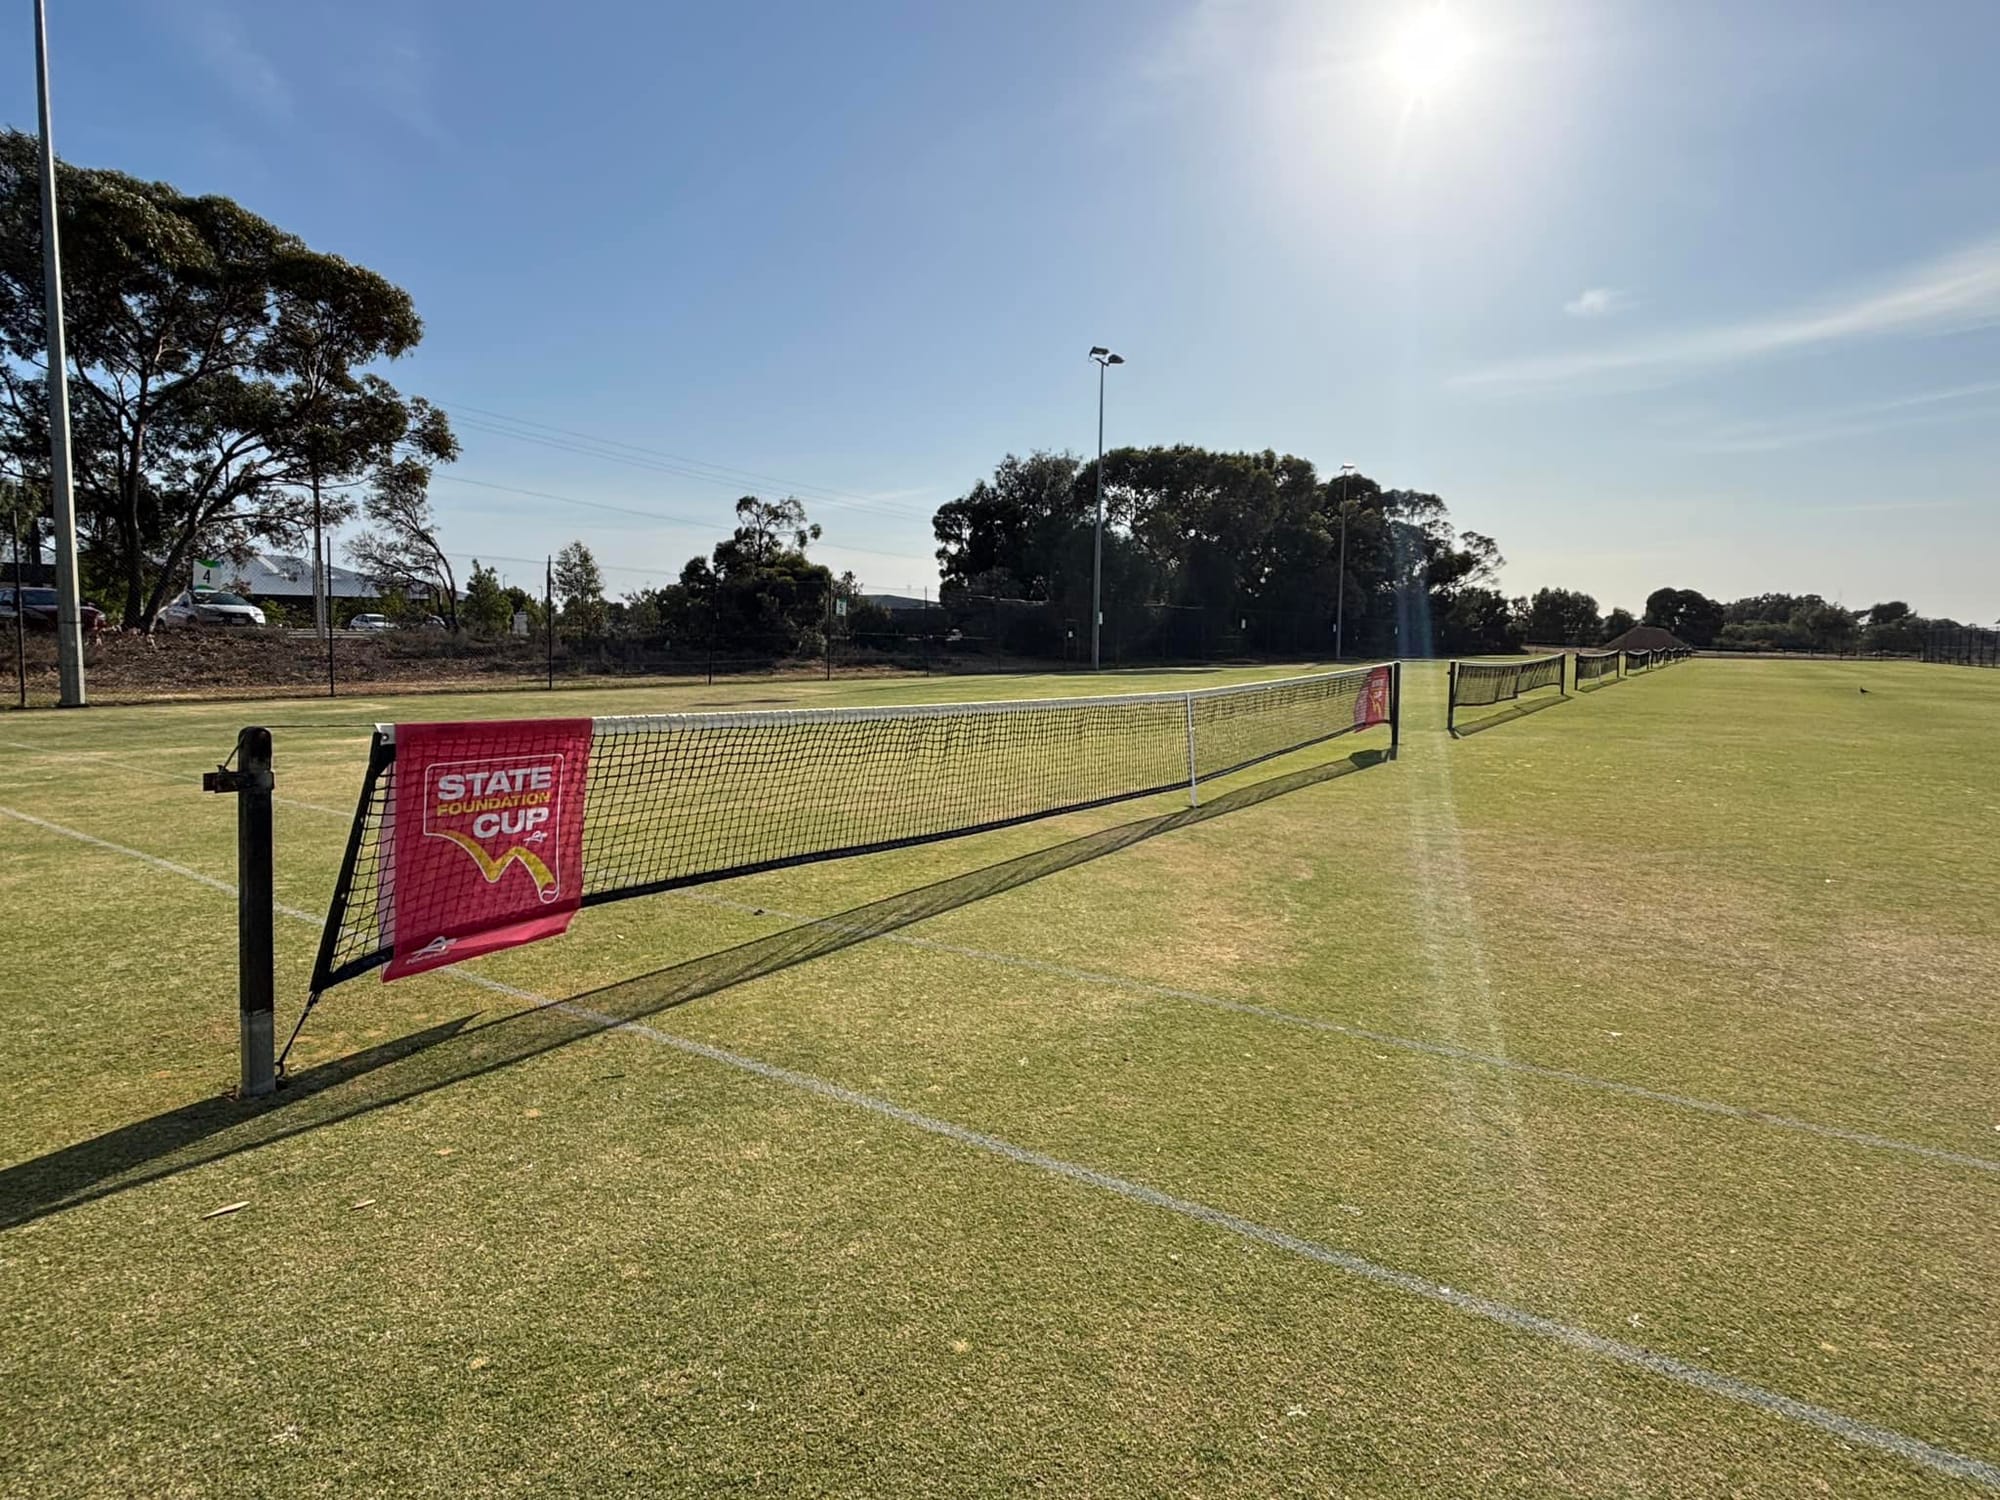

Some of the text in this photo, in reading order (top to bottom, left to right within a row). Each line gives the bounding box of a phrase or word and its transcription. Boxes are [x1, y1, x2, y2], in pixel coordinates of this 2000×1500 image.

[203, 569, 210, 584] 4
[437, 766, 553, 801] STATE
[436, 791, 551, 817] FOUNDATION
[472, 807, 549, 839] CUP
